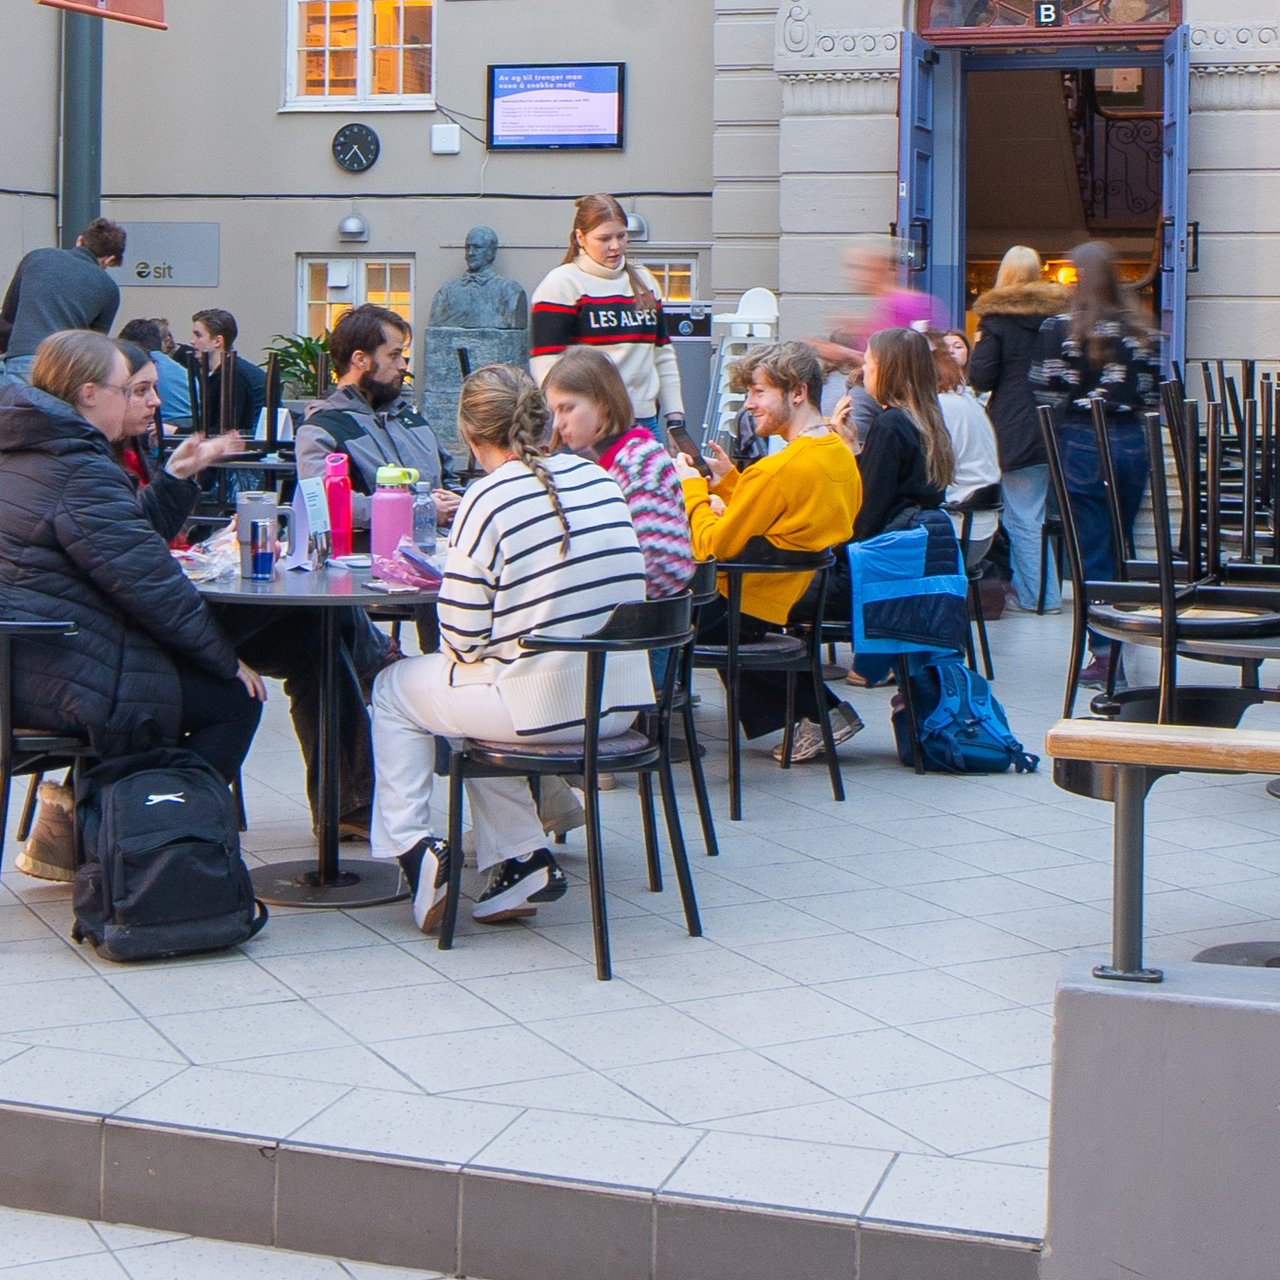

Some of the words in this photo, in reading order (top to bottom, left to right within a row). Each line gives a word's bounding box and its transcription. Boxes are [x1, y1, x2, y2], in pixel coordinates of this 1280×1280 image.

[1040, 4, 1056, 22] B
[153, 262, 173, 279] sit
[589, 310, 618, 328] LES
[620, 308, 658, 327] ALPES
